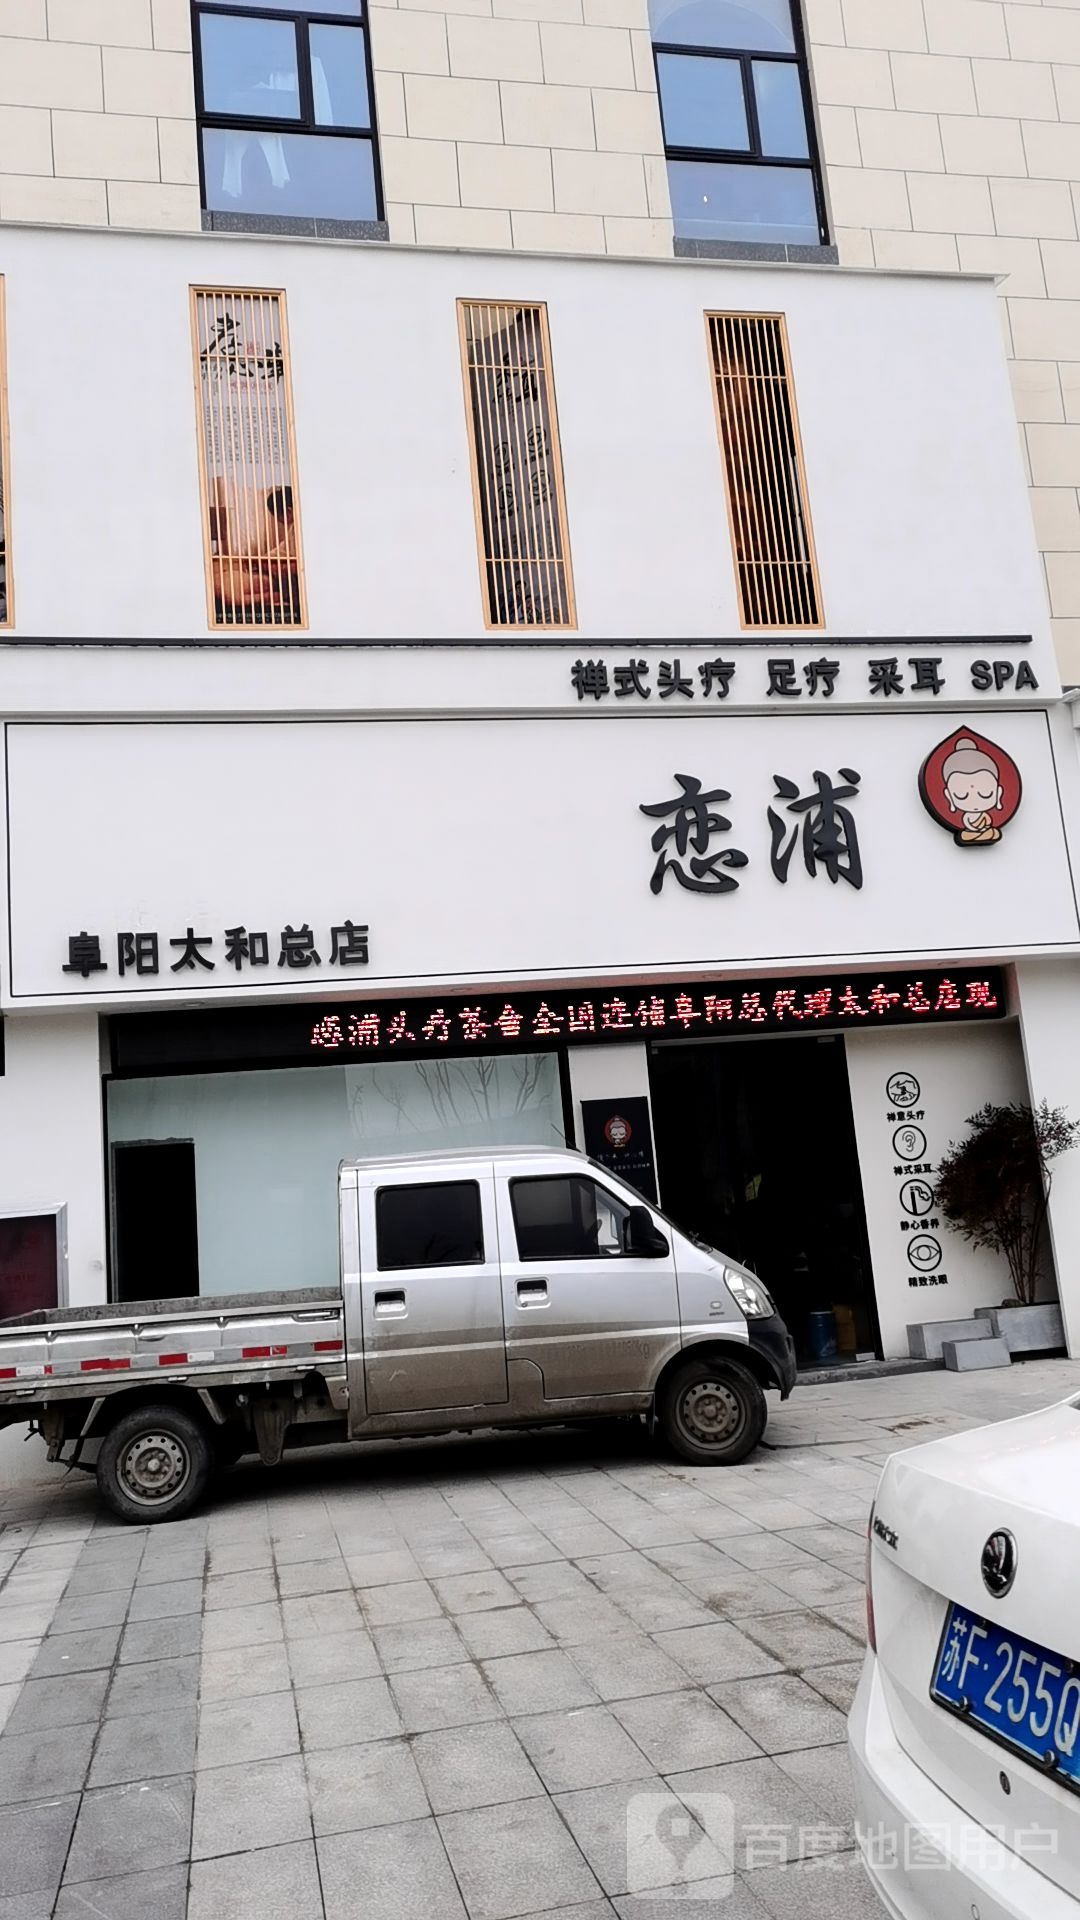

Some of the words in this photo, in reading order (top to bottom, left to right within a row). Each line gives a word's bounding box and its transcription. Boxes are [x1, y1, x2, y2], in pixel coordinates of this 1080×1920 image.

[571, 658, 735, 700] 禅式头疗
[767, 658, 839, 697] 足疗
[869, 658, 945, 696] 采耳
[971, 661, 1038, 691] SPA
[639, 768, 863, 895] 恋浦
[62, 920, 369, 977] 阜阳太和总店
[886, 1110, 925, 1122] 禅意头疗
[893, 1163, 933, 1176] 禅式采耳
[908, 1274, 948, 1287] 精致洗眼
